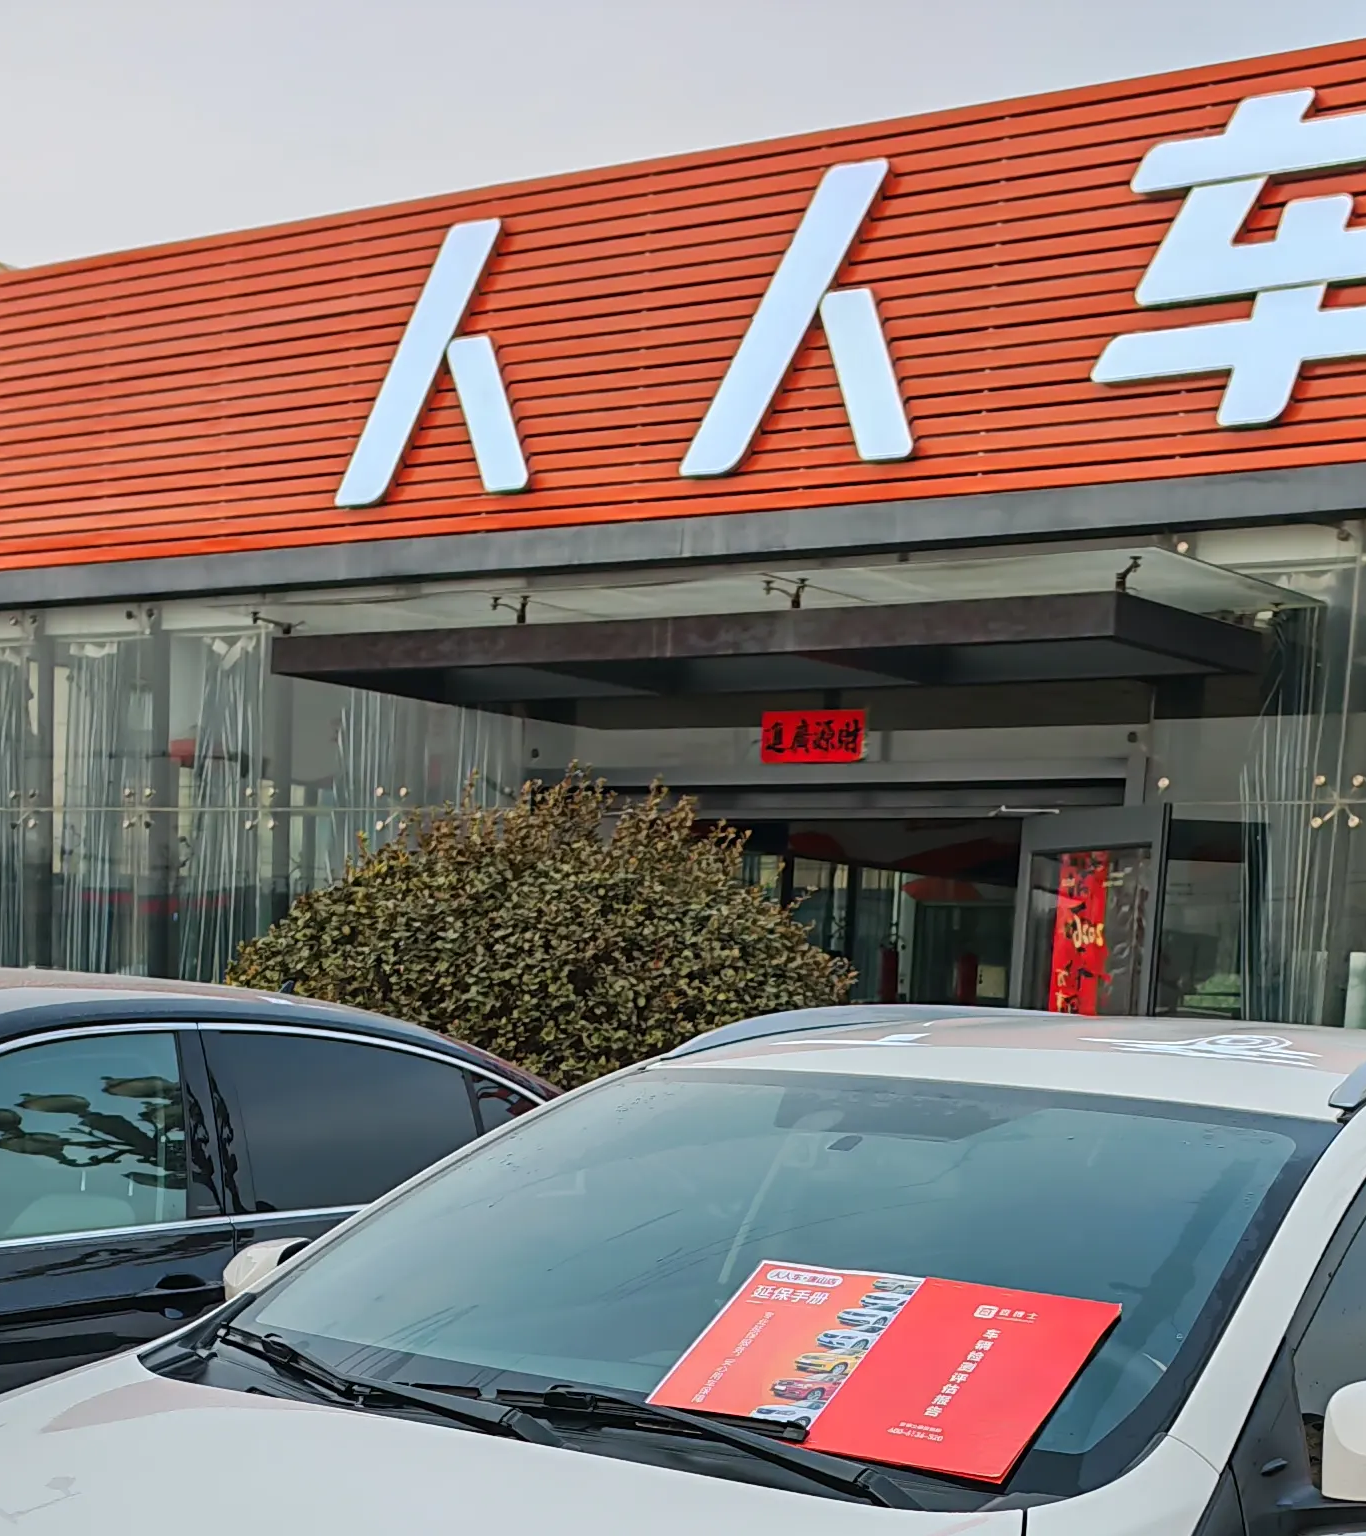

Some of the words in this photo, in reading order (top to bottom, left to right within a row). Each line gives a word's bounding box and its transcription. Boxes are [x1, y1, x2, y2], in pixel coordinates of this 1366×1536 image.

[751, 1285, 830, 1305] 延保手册
[923, 1328, 1001, 1418] 车辆检测评估报告
